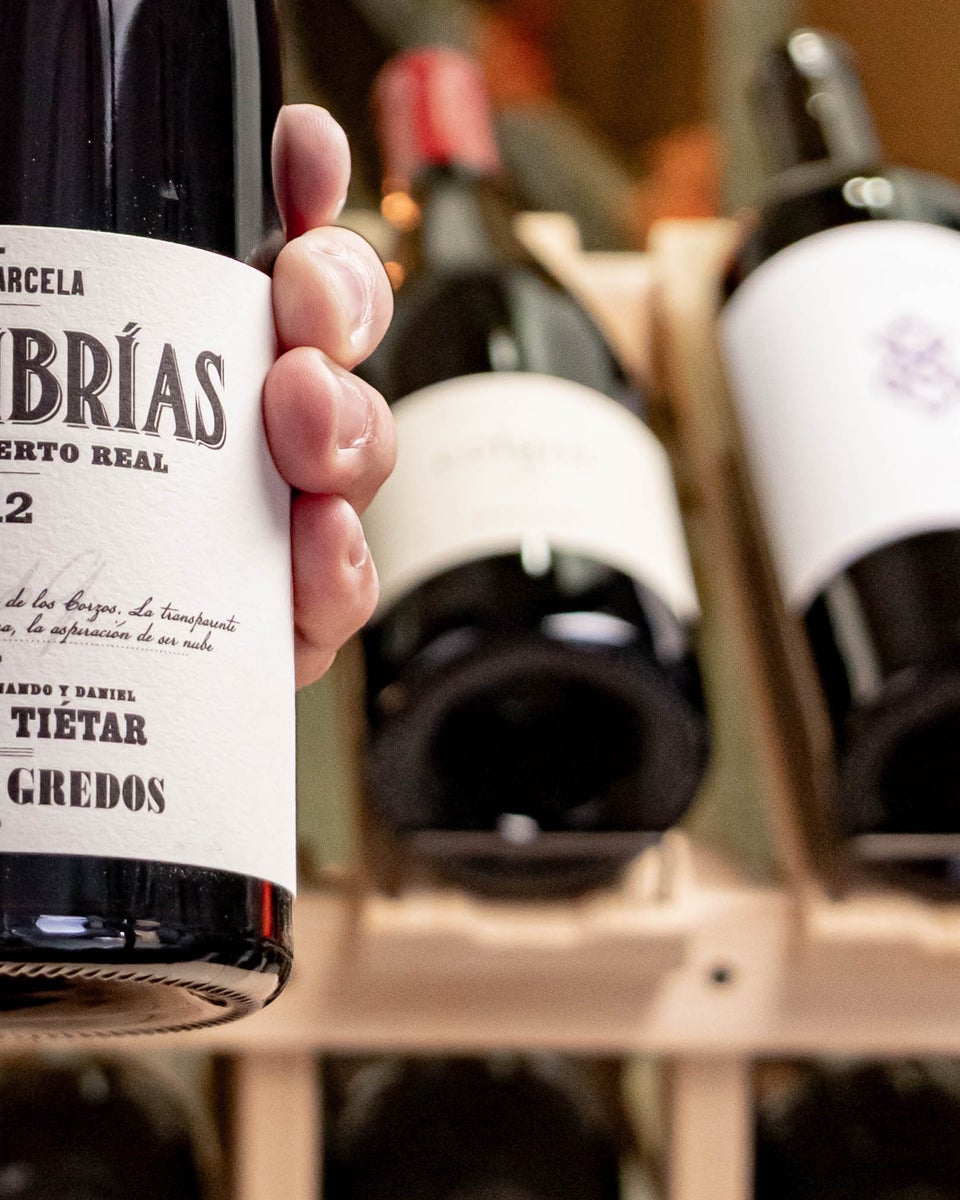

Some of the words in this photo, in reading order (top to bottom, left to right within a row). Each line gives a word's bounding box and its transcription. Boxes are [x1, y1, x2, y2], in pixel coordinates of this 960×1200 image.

[91, 445, 169, 473] REAL
[5, 587, 26, 608] de
[31, 588, 56, 609] los
[64, 589, 121, 623] Corzos.
[128, 596, 155, 618] La
[160, 602, 240, 633] transparente
[26, 613, 46, 634] la
[50, 620, 132, 644] aspiración
[136, 622, 155, 643] de
[157, 635, 179, 646] ser
[183, 630, 215, 652] nube
[59, 685, 69, 697] Y
[75, 686, 136, 702] DANIEL
[11, 700, 148, 746] TIÉTAR
[7, 767, 166, 815] GREDOS
